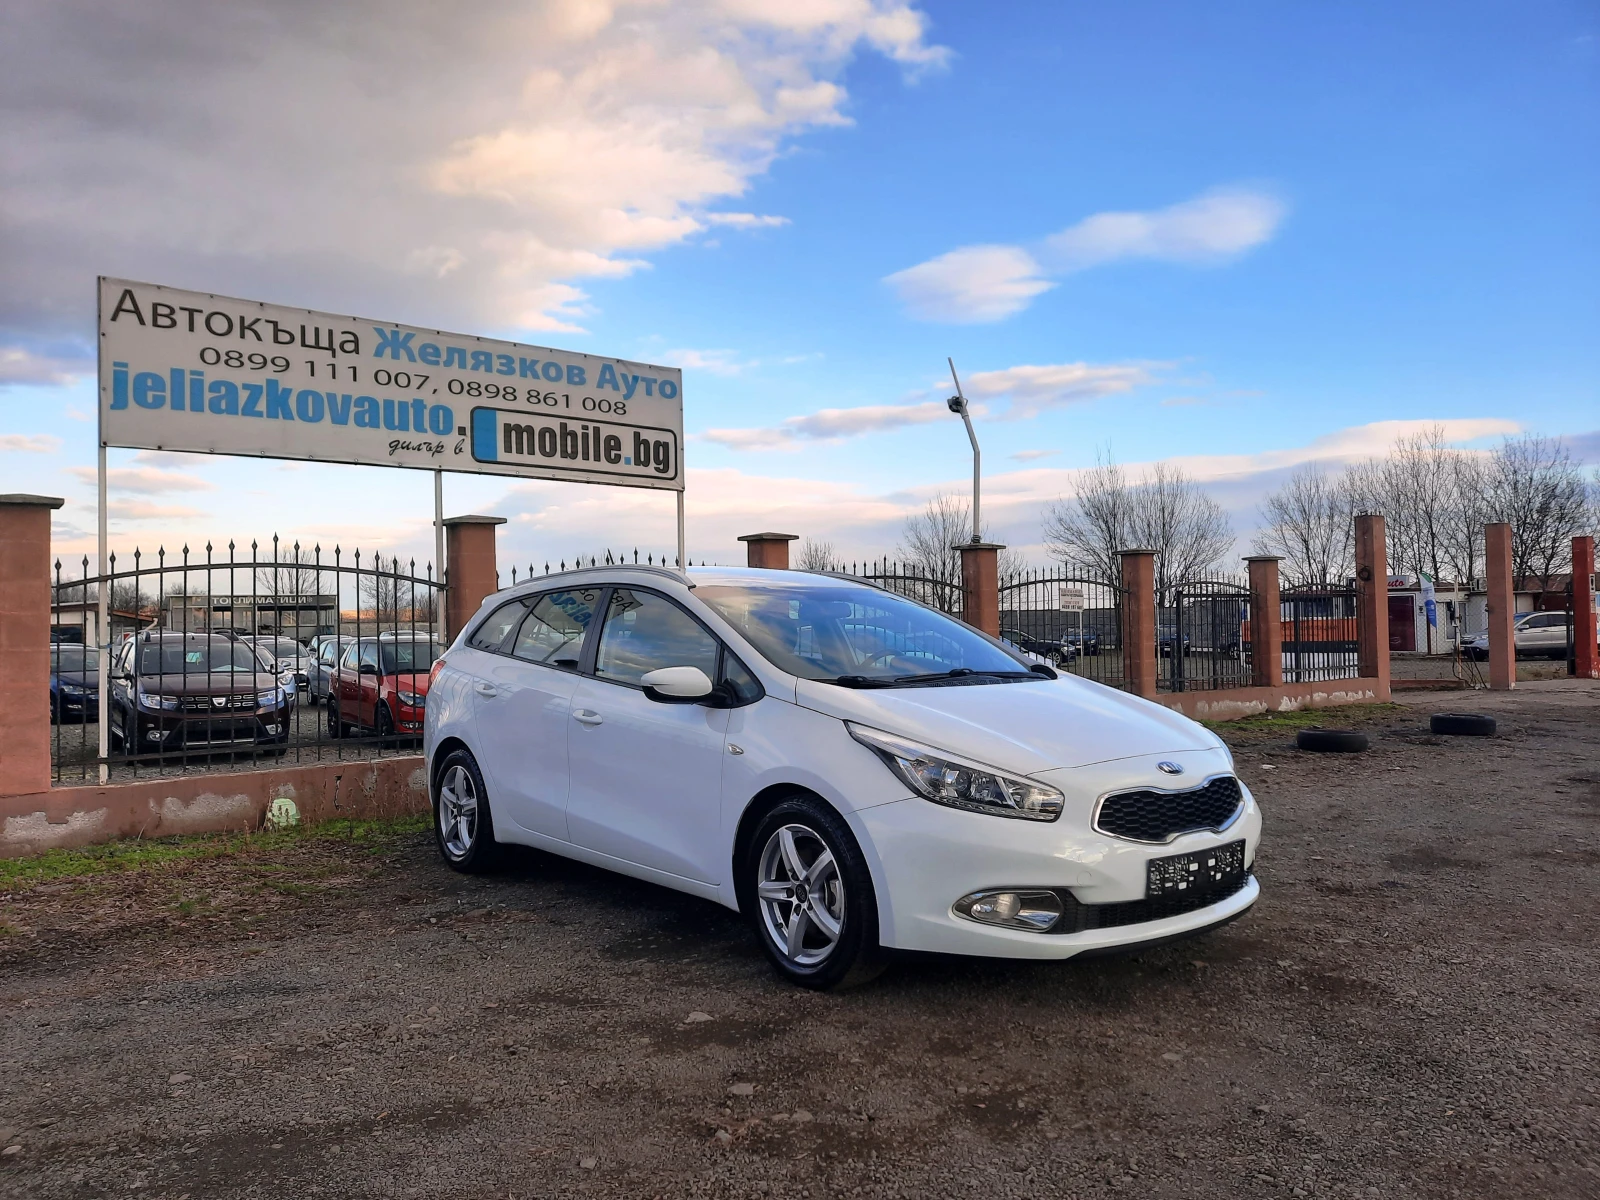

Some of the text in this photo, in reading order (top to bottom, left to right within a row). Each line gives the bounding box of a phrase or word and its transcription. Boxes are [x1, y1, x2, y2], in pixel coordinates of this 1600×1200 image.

[200, 347, 627, 415] 0899 111 007, 0898 861 008
[373, 327, 586, 386] Желязков
[596, 364, 678, 400] Ауто
[503, 422, 670, 473] mobile.bg
